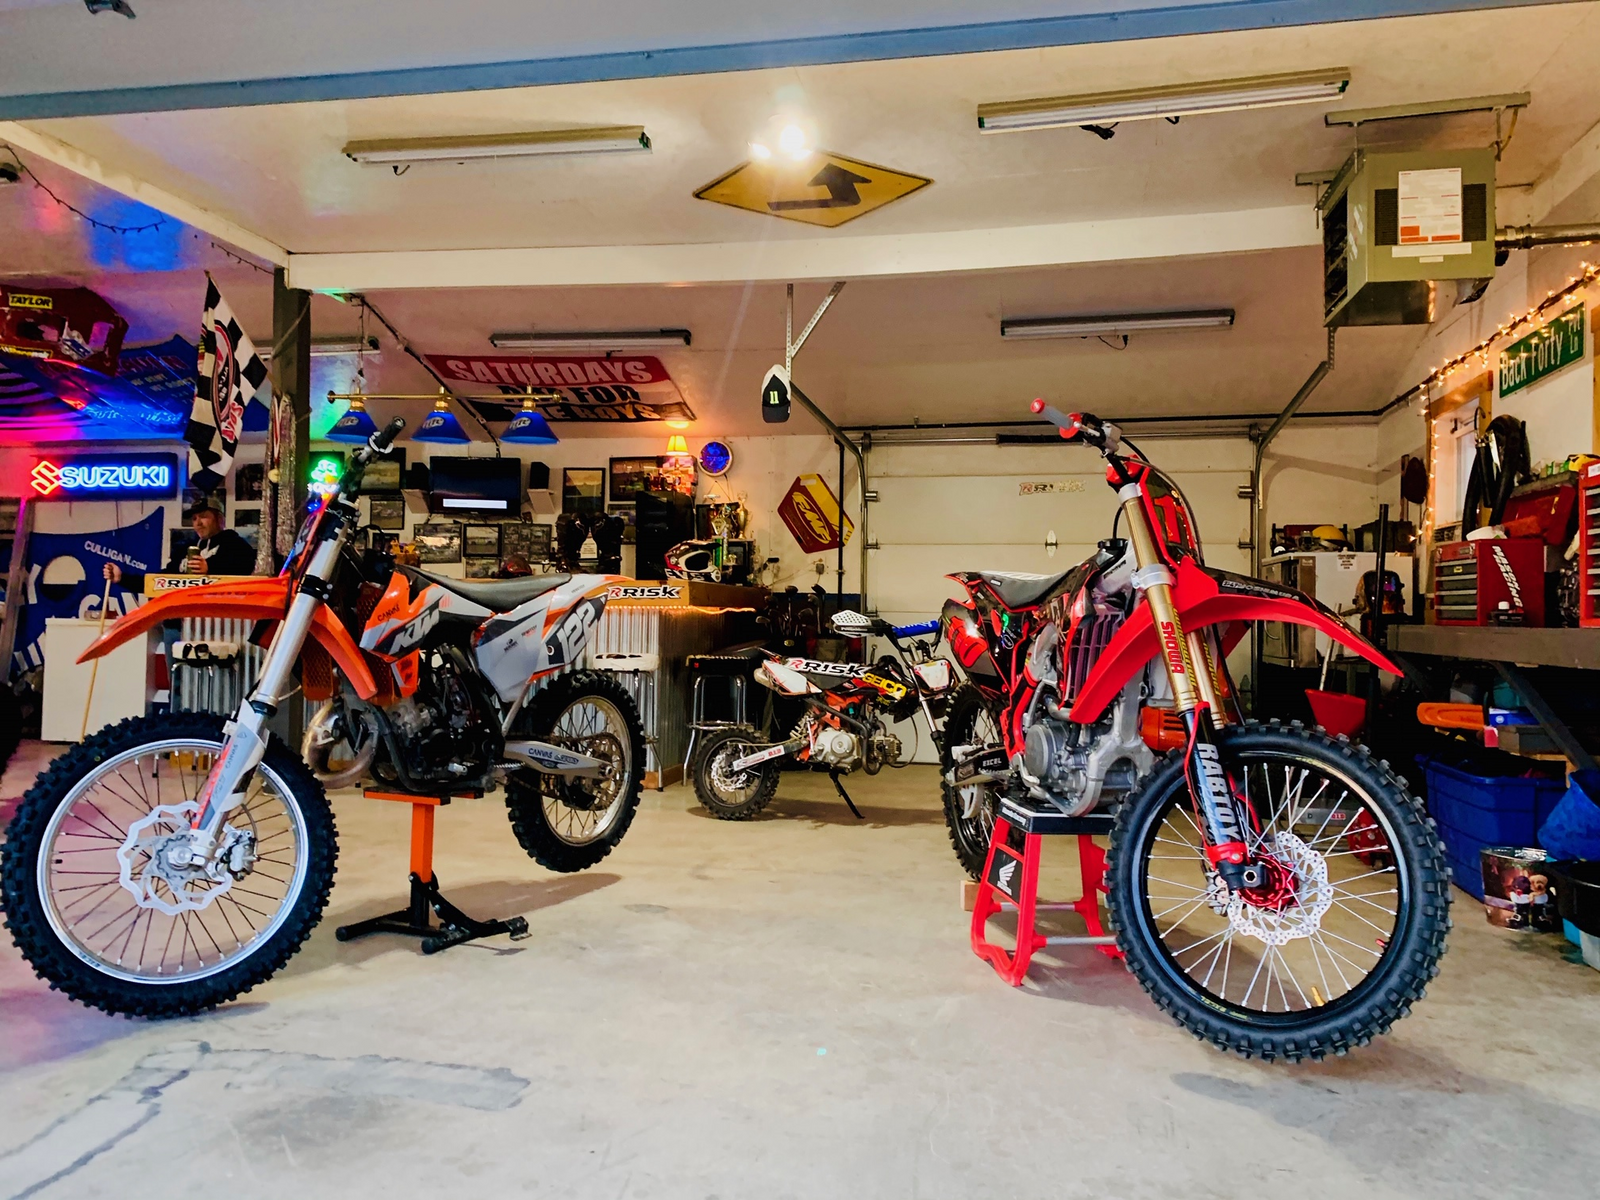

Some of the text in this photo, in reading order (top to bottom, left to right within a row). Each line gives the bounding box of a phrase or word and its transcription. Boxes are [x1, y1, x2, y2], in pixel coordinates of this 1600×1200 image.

[11, 296, 50, 306] TAYLOR
[446, 359, 652, 386] SATURDAYS
[1502, 327, 1563, 390] Back Forty
[568, 384, 641, 403] FOR
[579, 404, 660, 420] BOYS
[58, 465, 170, 488] SUZUKI
[1492, 546, 1521, 590] MASON
[1492, 554, 1523, 608] RACING
[388, 607, 440, 655] KTM
[556, 602, 598, 666] 122
[1160, 621, 1185, 674] SHOWA
[862, 672, 907, 700] GEICO
[528, 747, 553, 759] CANVAS
[1197, 743, 1242, 841] RABTOY
